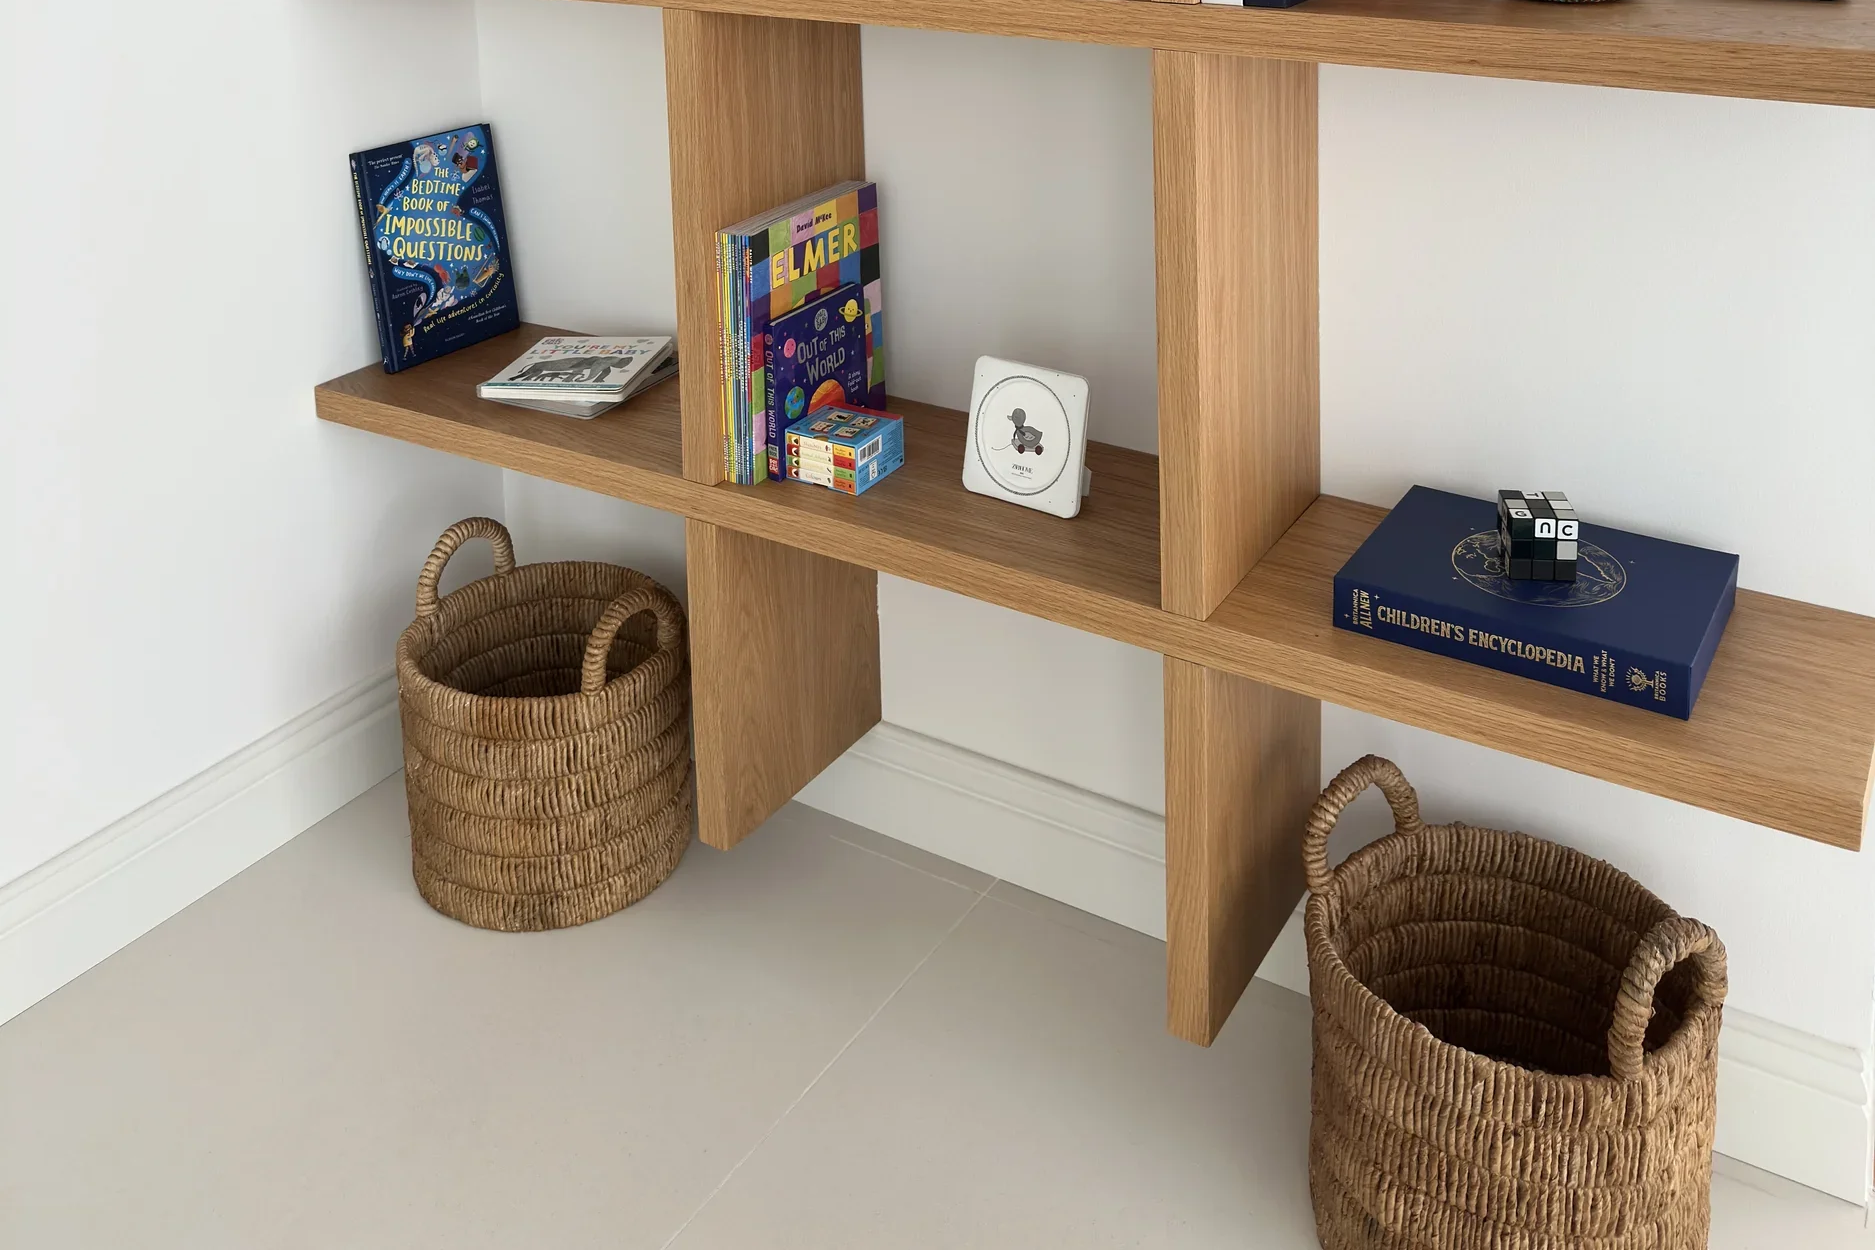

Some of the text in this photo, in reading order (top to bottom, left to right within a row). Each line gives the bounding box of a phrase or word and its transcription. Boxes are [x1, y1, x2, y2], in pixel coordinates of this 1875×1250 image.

[434, 166, 450, 178] THE
[411, 178, 461, 196] BEDTIME
[403, 196, 450, 212] BOOK OF
[384, 214, 473, 241] IMPOSSIBLE
[796, 218, 814, 234] David
[392, 236, 484, 261] QUESTIONS
[772, 222, 858, 289] ELMER
[394, 268, 404, 276] WHY
[448, 302, 478, 319] adventures
[796, 324, 846, 364] OUT OF THIS
[765, 350, 774, 370] OUT
[806, 347, 846, 386] WORLD
[766, 372, 775, 385] OF
[767, 387, 775, 406] THIS
[768, 410, 776, 439] WORLD
[1377, 605, 1585, 674] CHILDREN'S ENCYCLOPEDIA
[1593, 655, 1600, 665] WE
[1608, 677, 1615, 687] WE
[1659, 671, 1667, 702] BOOKS
